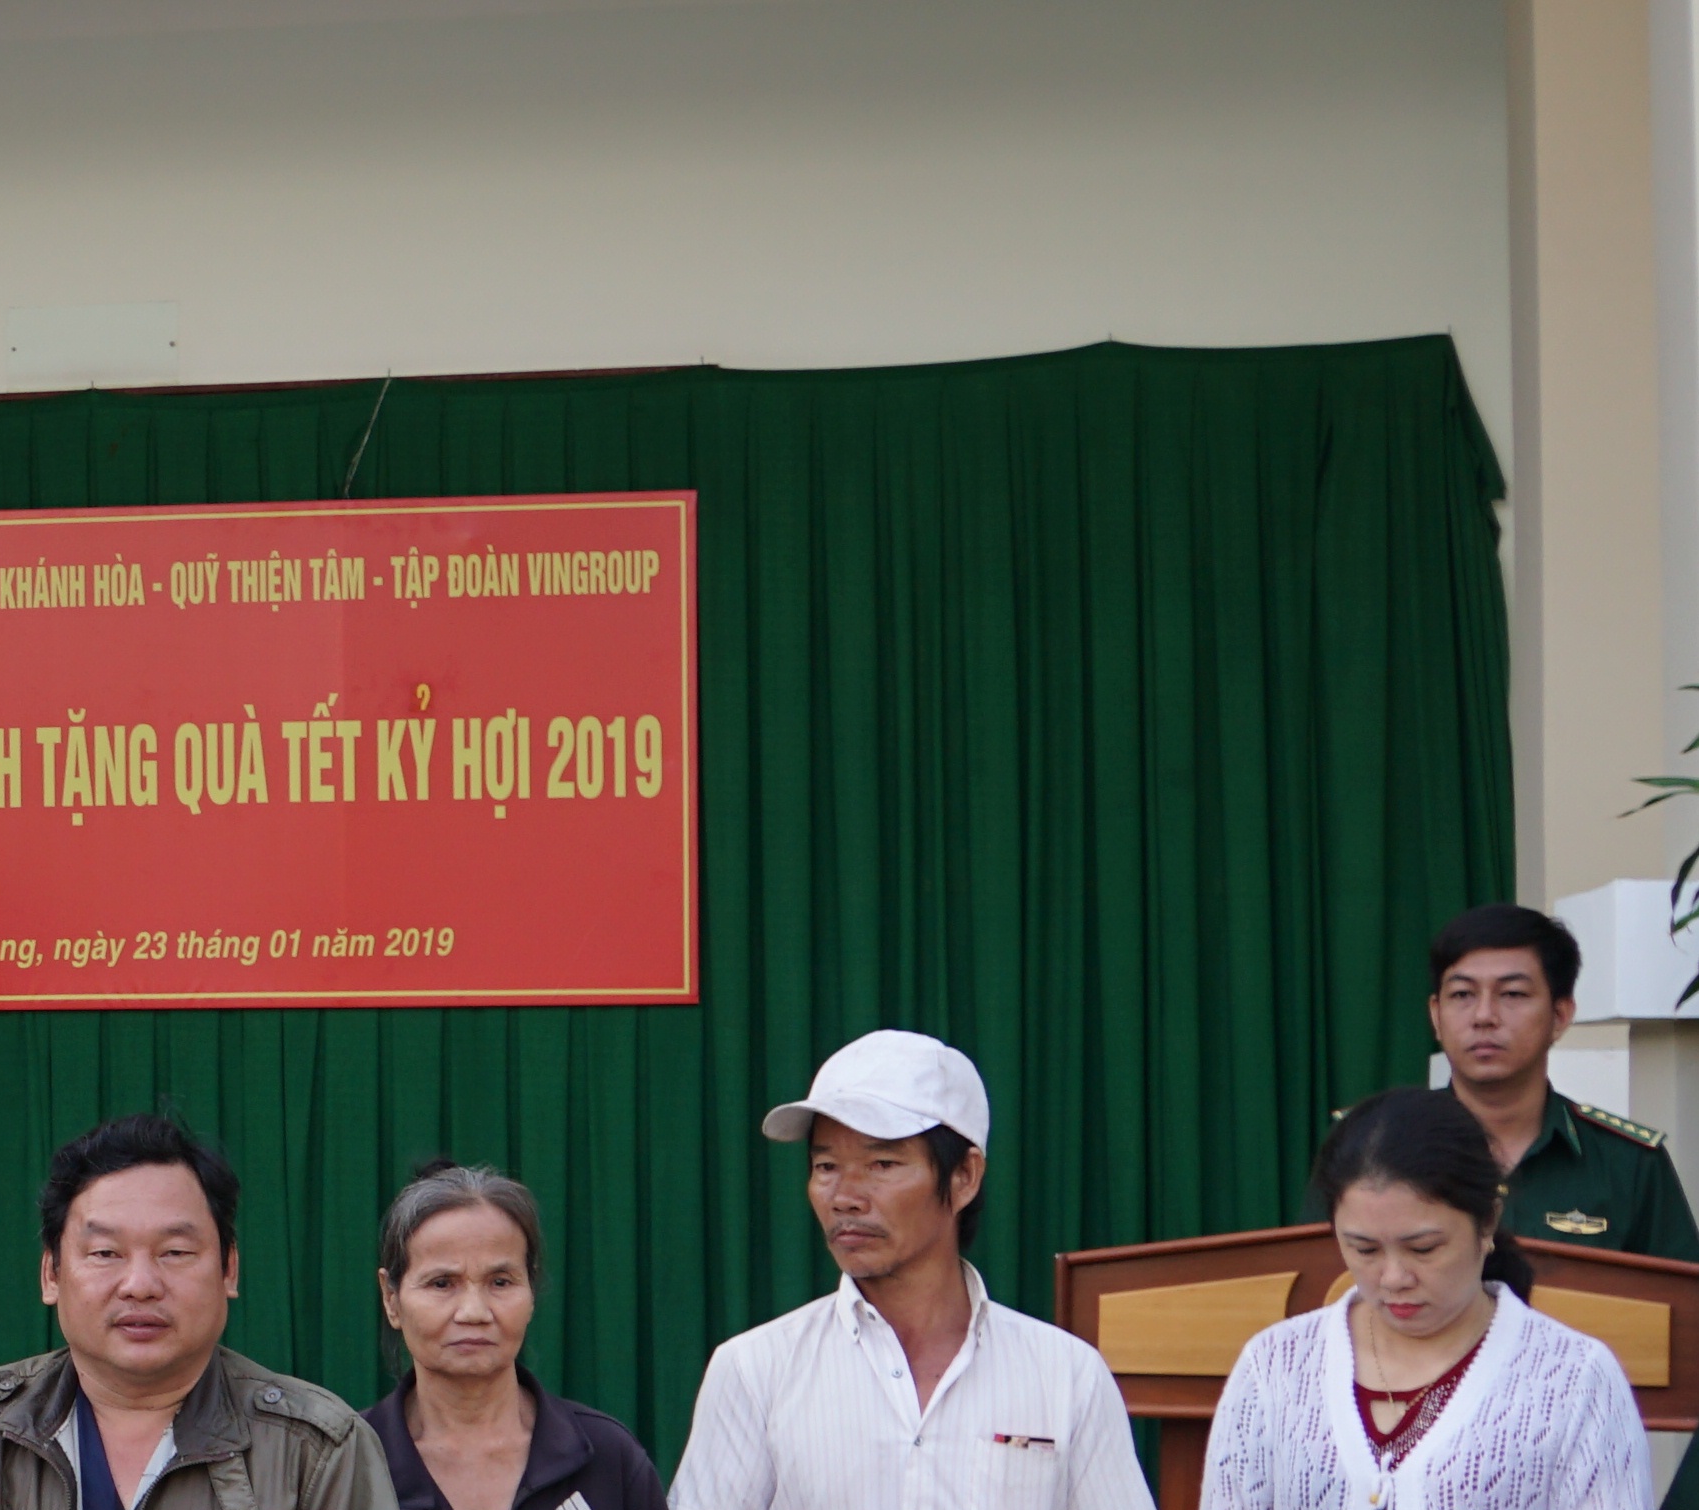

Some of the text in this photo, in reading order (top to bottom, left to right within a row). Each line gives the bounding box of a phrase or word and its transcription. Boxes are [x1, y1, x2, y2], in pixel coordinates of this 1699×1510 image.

[0, 558, 84, 609] KHÁNH
[94, 554, 144, 606] HÒA
[152, 582, 161, 590] -
[170, 554, 219, 609] QUỸ
[227, 551, 300, 610] THIỆN
[309, 549, 364, 600] TÂM
[373, 576, 382, 585] -
[390, 548, 438, 607] TẬP
[447, 545, 518, 597] ĐOÀN
[527, 550, 658, 595] VINGROUP
[36, 708, 157, 825] TẶNG
[174, 704, 268, 814] QUÀ
[281, 692, 361, 802] TẾT
[377, 684, 435, 800] KỶ
[452, 708, 529, 818] HỢI
[547, 714, 661, 798] 2019
[53, 930, 125, 967] ngày
[132, 931, 167, 959] 23
[177, 928, 259, 965] tháng
[269, 929, 300, 957] 01
[312, 927, 374, 957] năm
[384, 927, 453, 956] 2019
